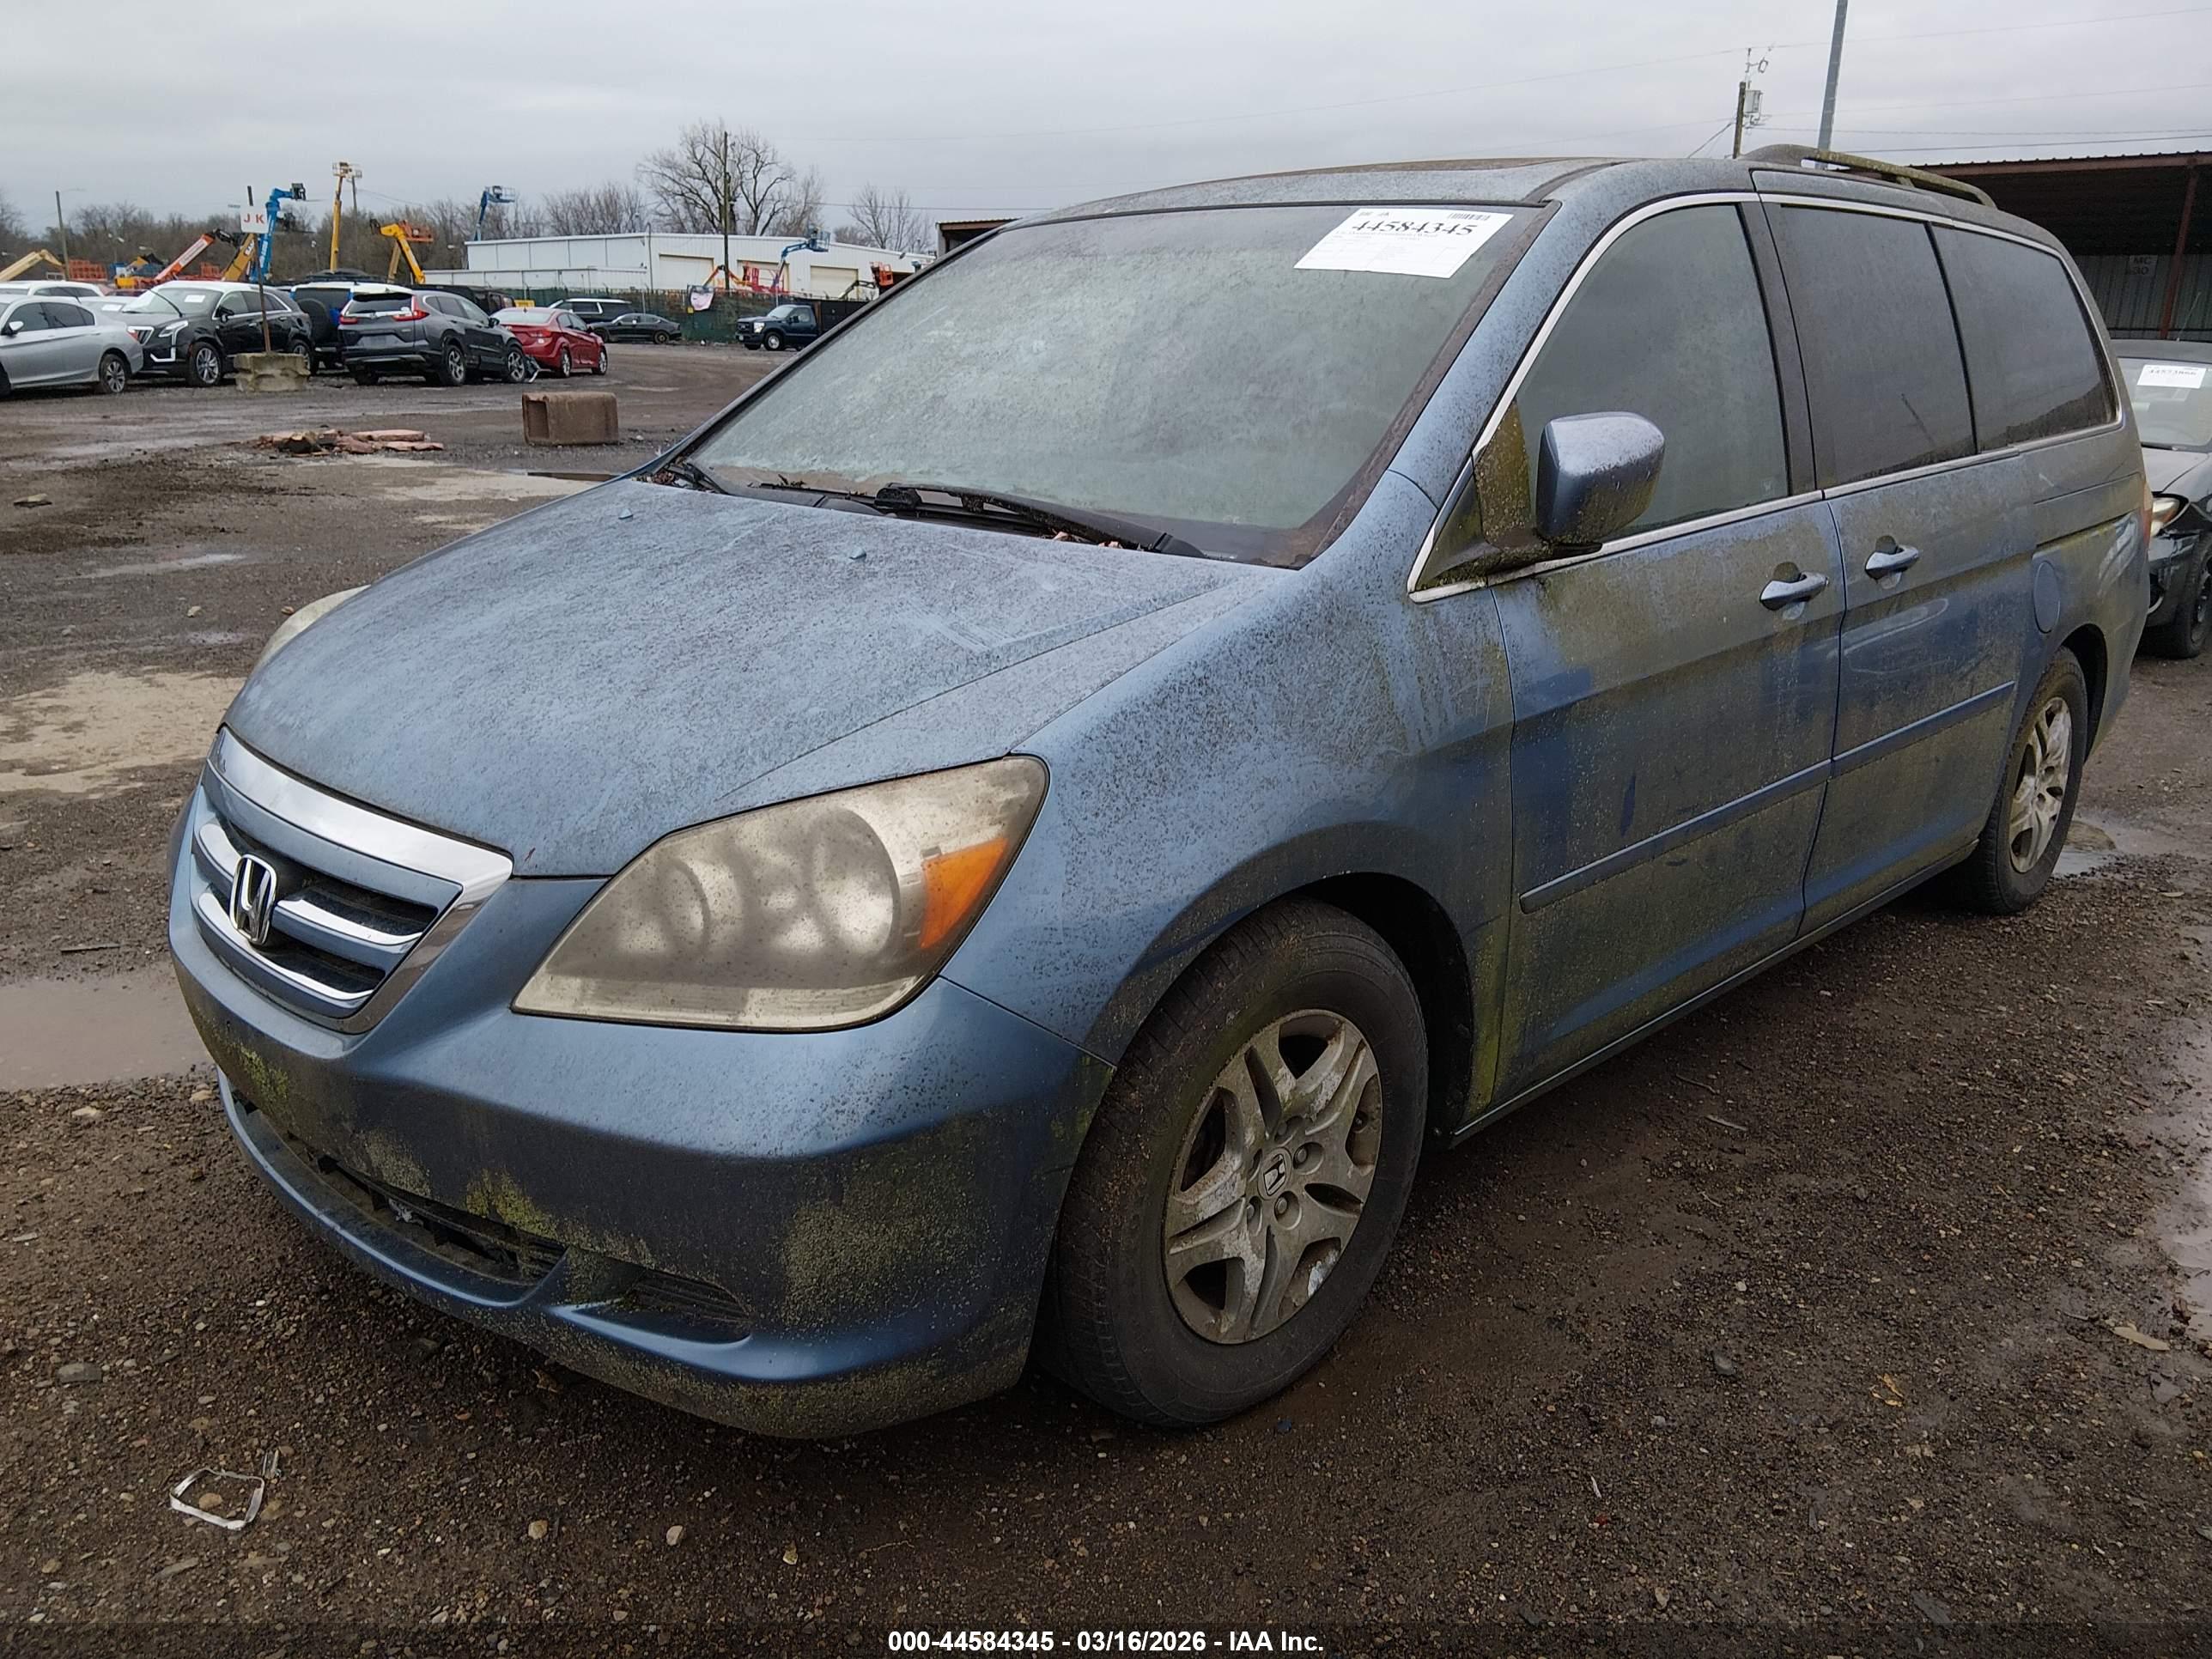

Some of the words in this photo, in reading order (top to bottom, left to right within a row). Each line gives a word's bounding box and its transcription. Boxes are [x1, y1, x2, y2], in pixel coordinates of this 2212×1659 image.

[244, 213, 251, 223] J
[255, 214, 264, 223] K
[1352, 220, 1478, 235] 44584345
